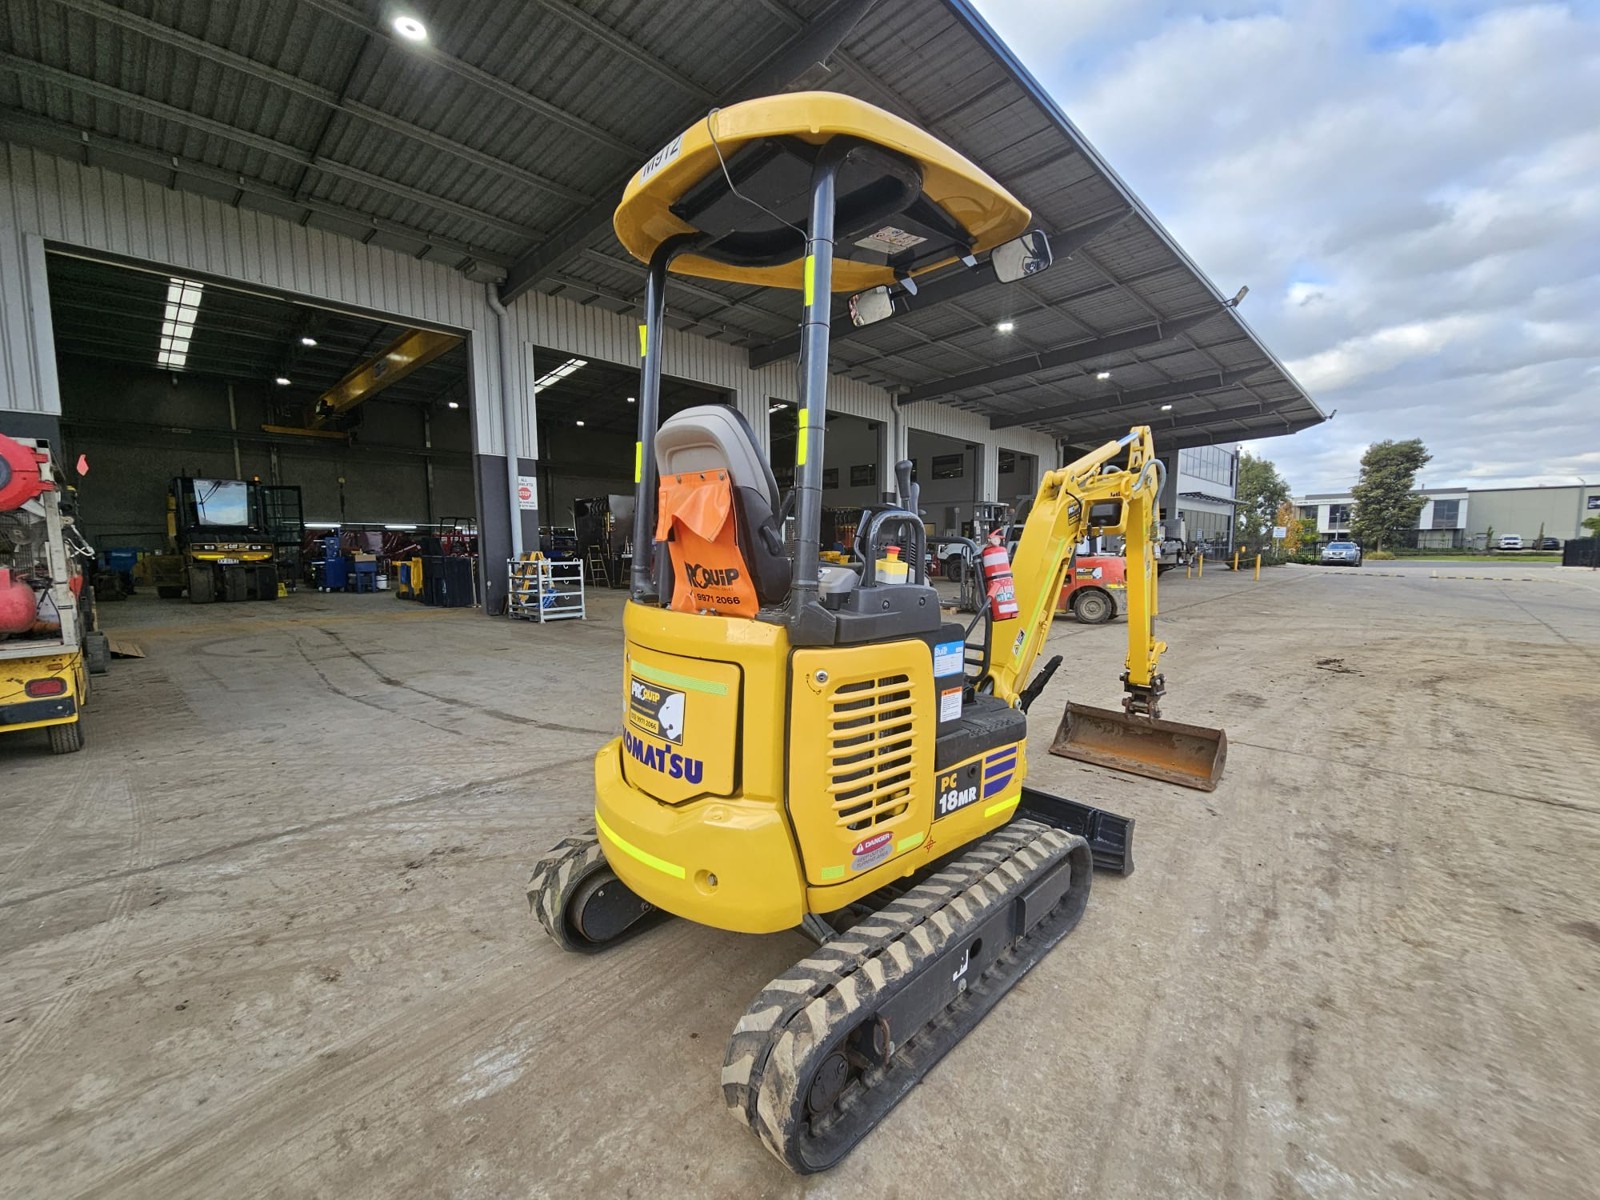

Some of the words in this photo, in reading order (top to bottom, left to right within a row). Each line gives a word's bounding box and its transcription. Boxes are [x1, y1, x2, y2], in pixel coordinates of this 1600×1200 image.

[716, 596, 740, 604] 2066
[646, 720, 657, 730] 2066
[941, 773, 957, 792] PC
[939, 786, 977, 814] 18MR
[865, 832, 891, 849] DANGER
